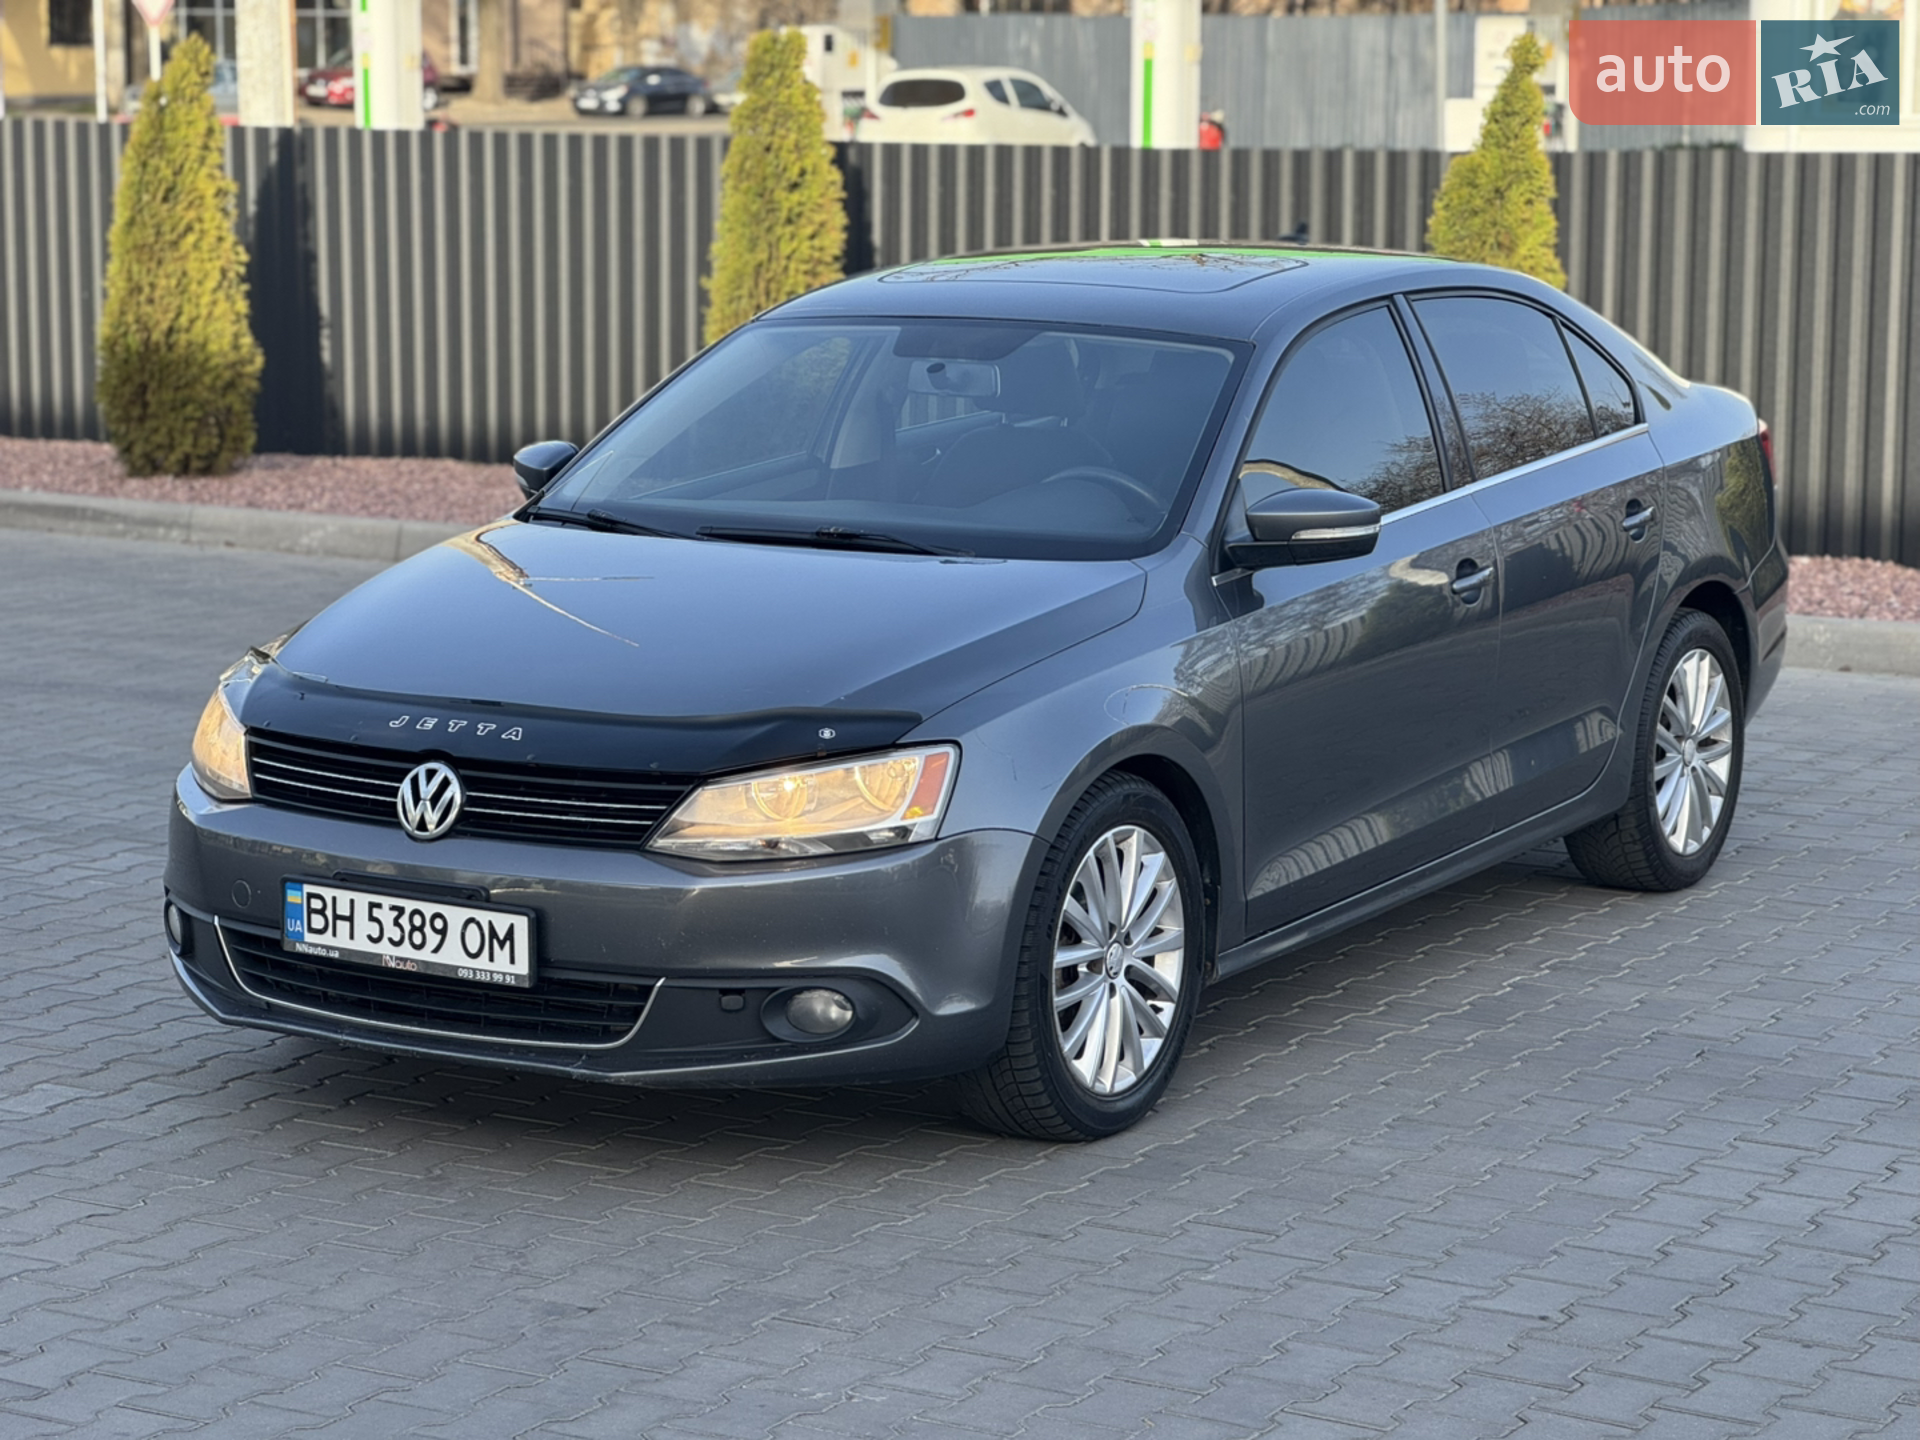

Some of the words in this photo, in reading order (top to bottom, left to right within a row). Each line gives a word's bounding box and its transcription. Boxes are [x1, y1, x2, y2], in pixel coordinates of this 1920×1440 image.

[388, 715, 523, 741] JETTA
[287, 918, 302, 933] UA
[306, 892, 355, 941] BH
[366, 901, 448, 954] 5389
[460, 917, 516, 965] OM
[295, 942, 339, 958] NNauto.ua
[457, 967, 474, 979] 093
[474, 969, 491, 981] 333
[491, 972, 504, 983] 99
[504, 974, 516, 984] 91
